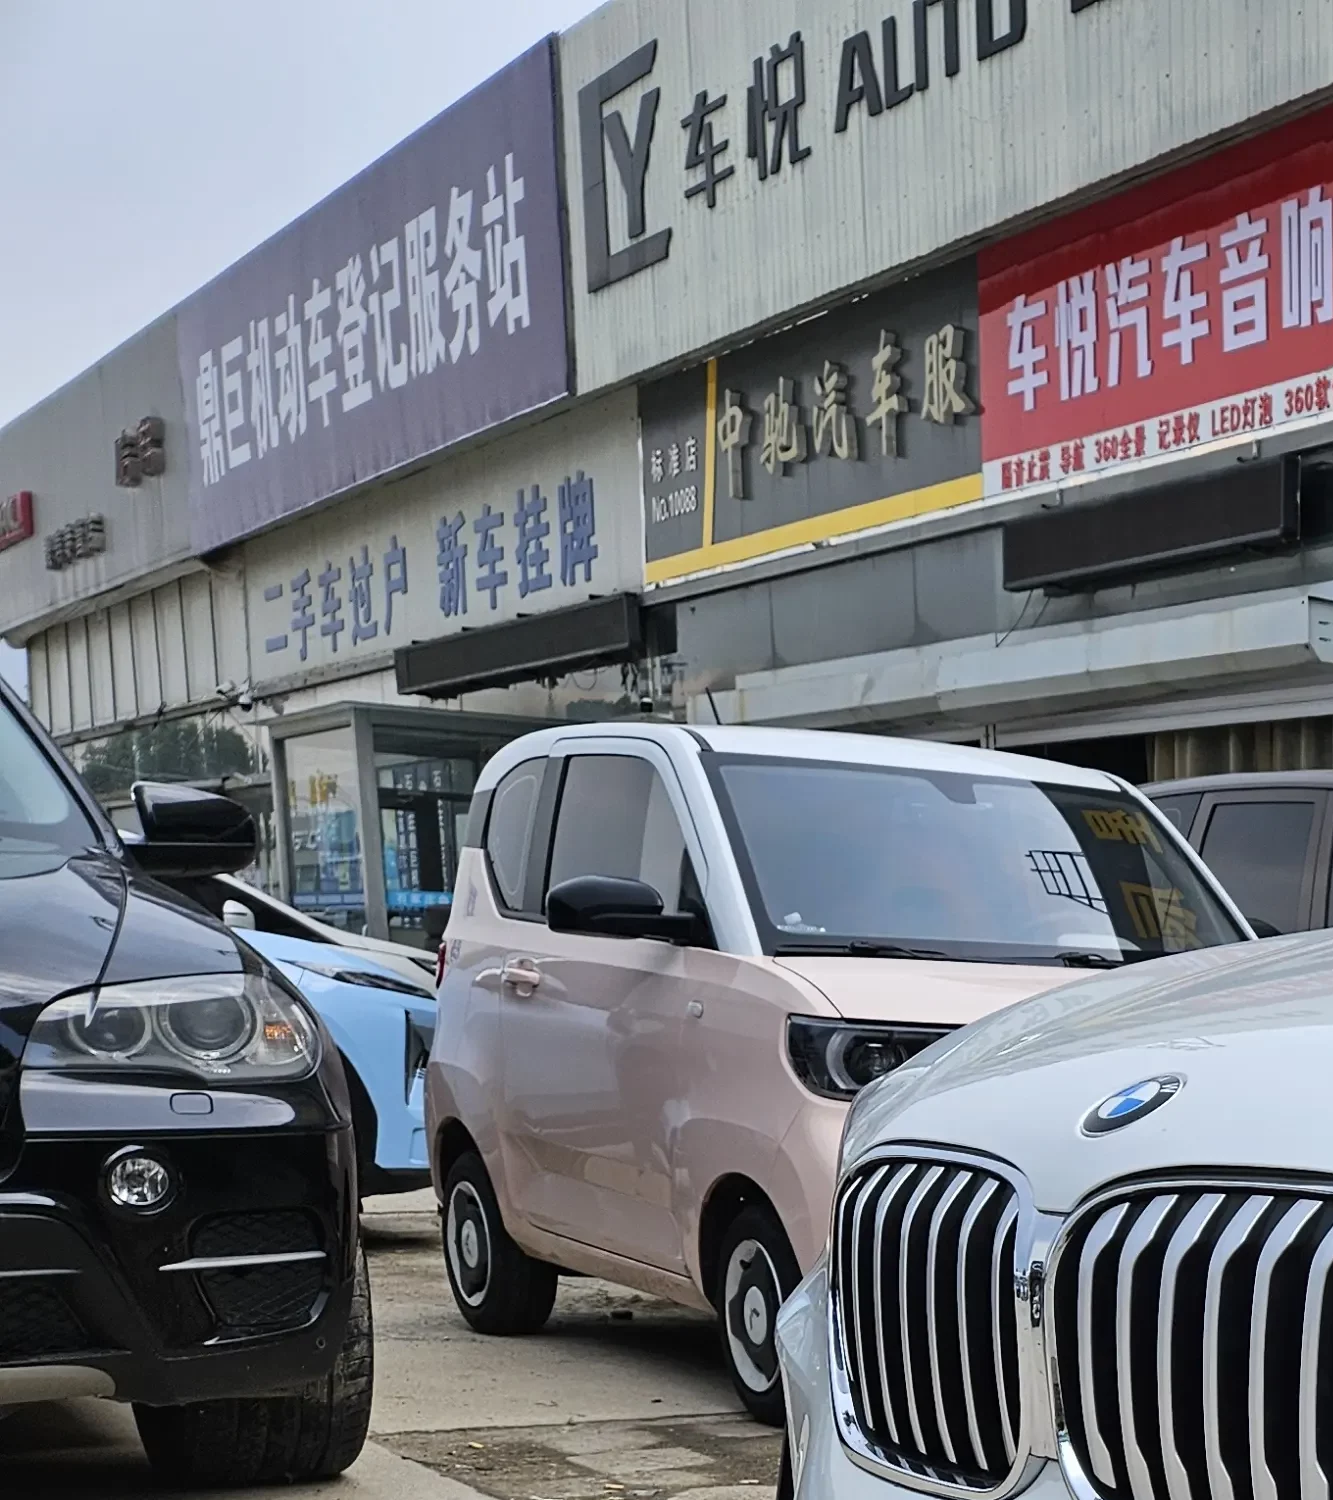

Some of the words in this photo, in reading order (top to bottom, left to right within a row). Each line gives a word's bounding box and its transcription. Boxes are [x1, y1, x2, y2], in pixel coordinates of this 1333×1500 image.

[680, 30, 812, 209] 车悦
[196, 152, 531, 487] 鼎巨机动车登记服务站
[651, 435, 697, 483] 标准店
[1094, 424, 1147, 464] 360全景
[1157, 411, 1201, 450] 记录仪
[1211, 391, 1274, 438] LED灯泡
[264, 534, 408, 661] 二手车过户
[436, 470, 599, 617] 新车挂牌
